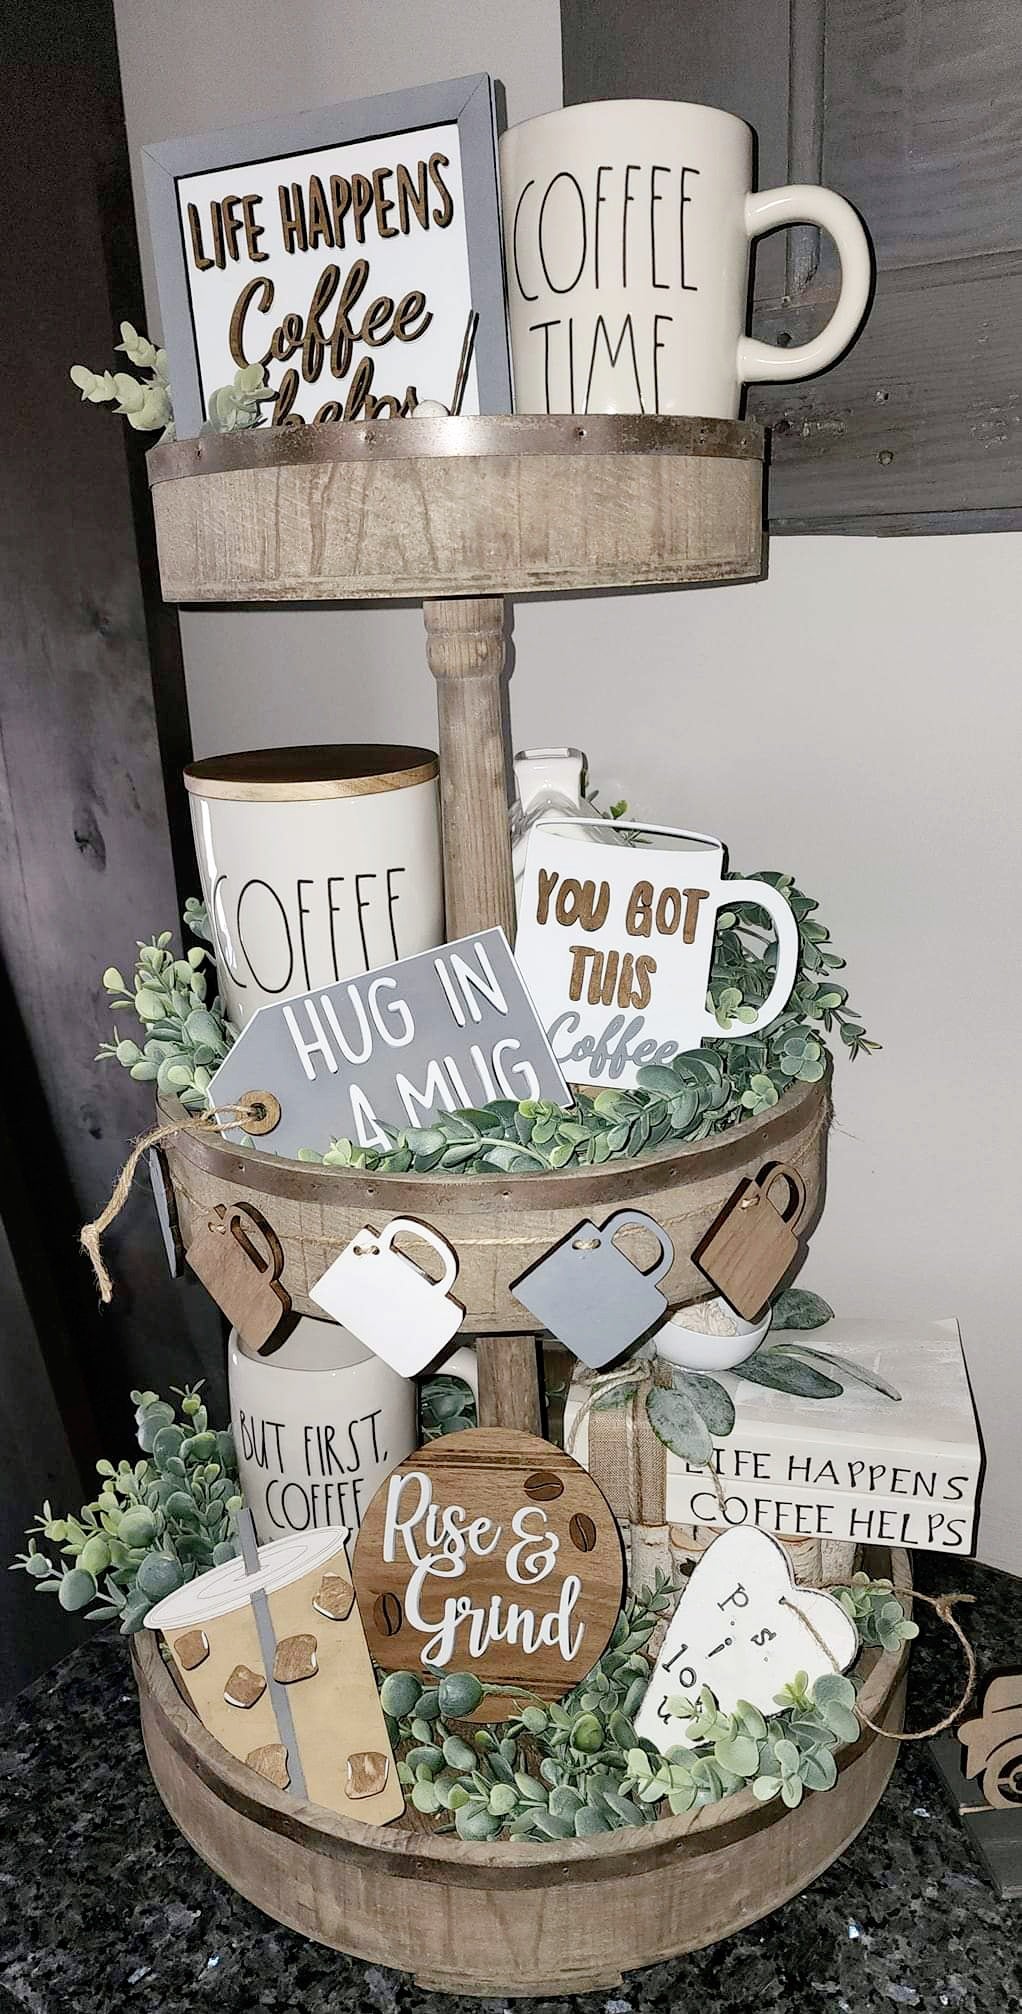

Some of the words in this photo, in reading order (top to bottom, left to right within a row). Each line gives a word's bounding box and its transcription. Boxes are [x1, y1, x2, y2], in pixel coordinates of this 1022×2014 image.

[187, 194, 269, 271] LIFE
[278, 152, 454, 253] HAPPENS
[513, 164, 700, 301] COFFEE
[229, 258, 434, 383] Coffee
[529, 313, 673, 414] TIME
[536, 868, 611, 932] YOU
[625, 880, 710, 944] GOT
[282, 976, 415, 1081] HUG
[434, 941, 509, 1027] IN
[568, 945, 657, 1009] THIS
[349, 1084, 392, 1151] A
[396, 1038, 540, 1128] MUG
[547, 1010, 679, 1079] Coffee
[239, 1410, 285, 1473] BUT
[304, 1409, 388, 1476] FIRST,
[788, 1454, 969, 1500] HAPPENS
[266, 1478, 364, 1531] COFFEE
[383, 1471, 502, 1567] Rise
[505, 1506, 560, 1585] &
[690, 1492, 835, 1534] COFFEE
[850, 1507, 971, 1547] HELPS
[404, 1553, 585, 1668] Grind
